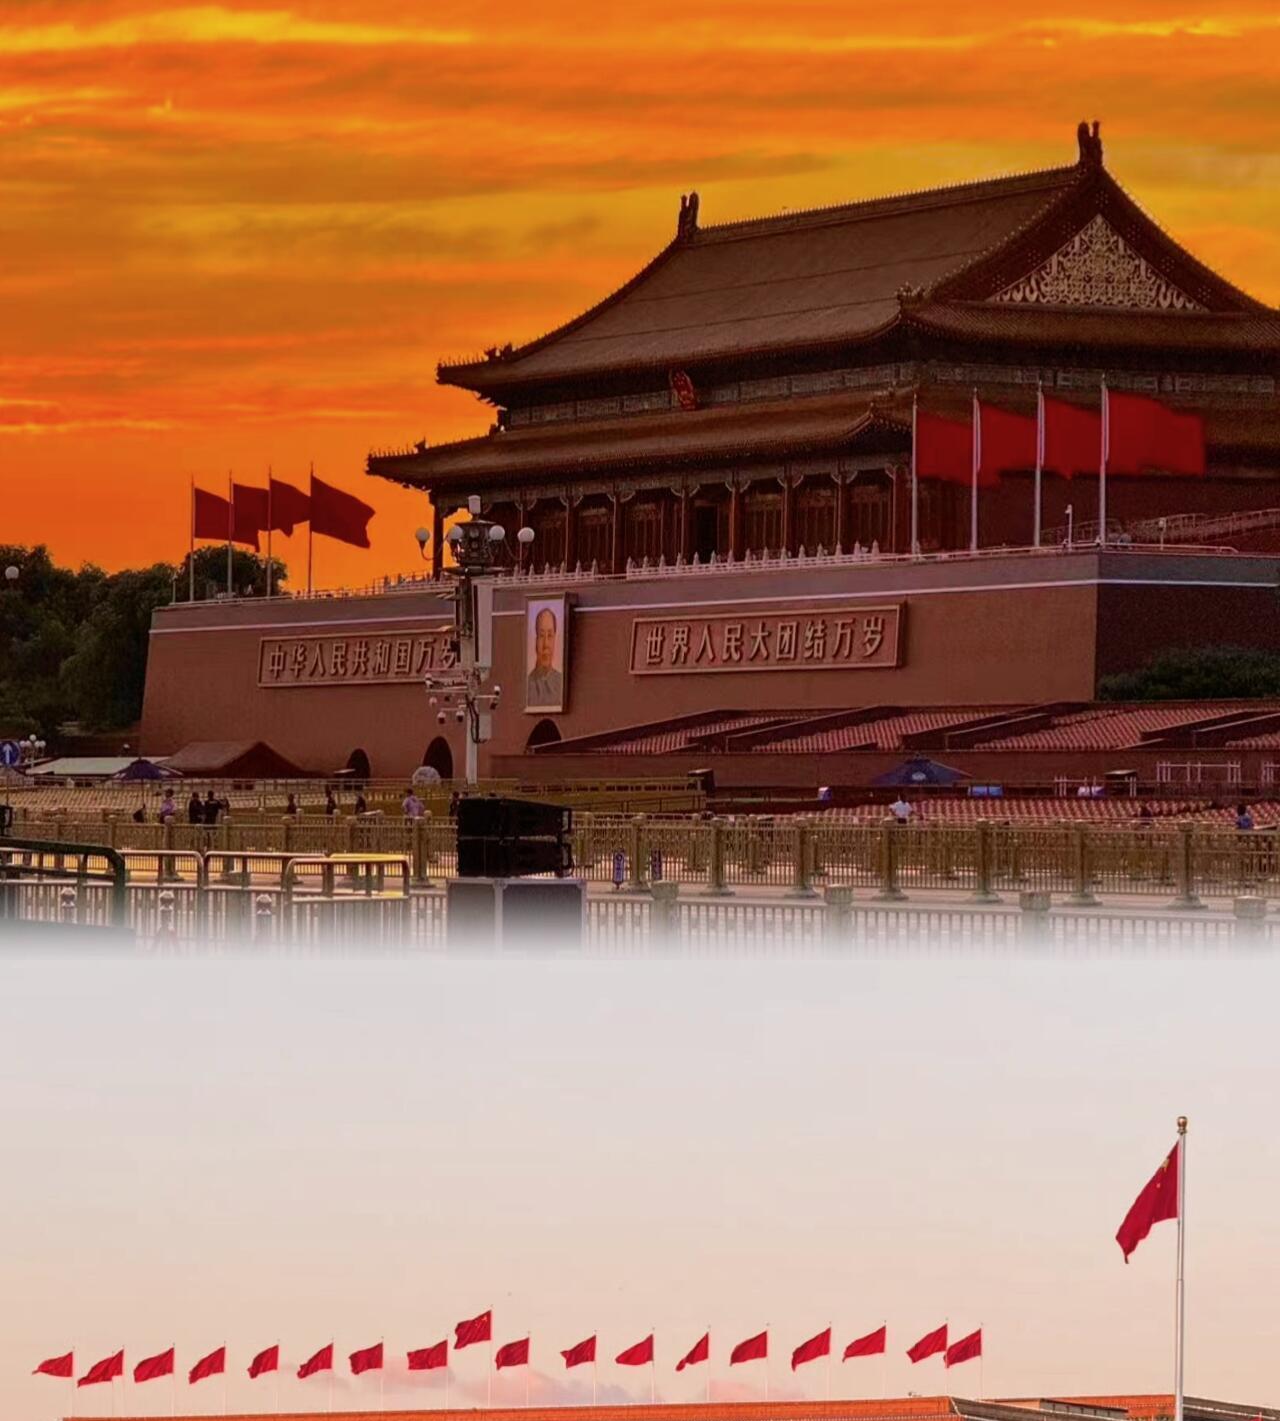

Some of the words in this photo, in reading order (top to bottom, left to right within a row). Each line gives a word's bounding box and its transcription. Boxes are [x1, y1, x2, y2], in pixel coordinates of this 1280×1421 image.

[270, 637, 456, 678] 中华人民共和国万岁
[646, 616, 885, 665] 世界人民大团结万岁
